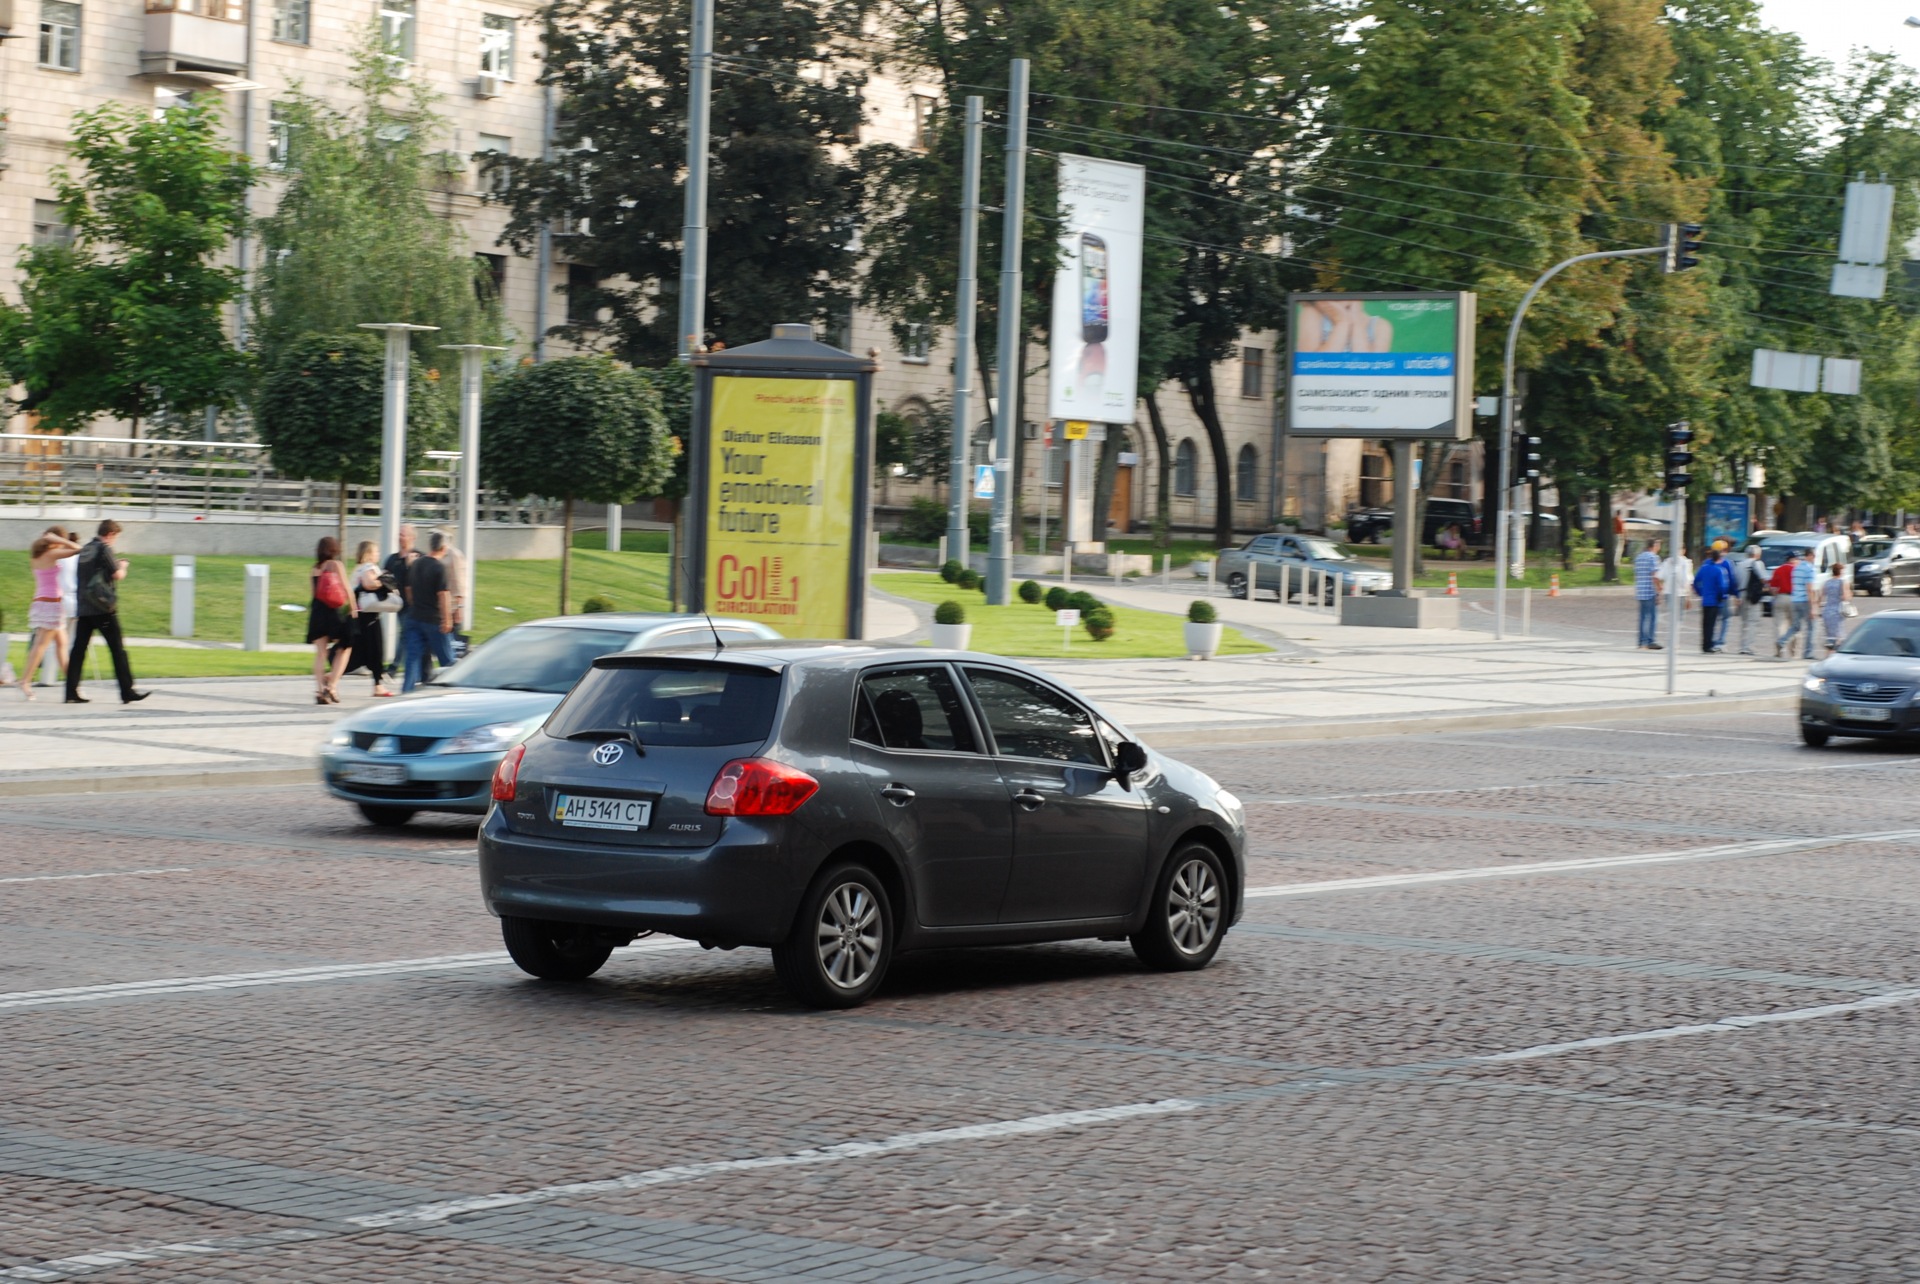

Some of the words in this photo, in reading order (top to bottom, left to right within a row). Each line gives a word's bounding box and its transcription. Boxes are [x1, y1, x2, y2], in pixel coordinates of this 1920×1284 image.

[768, 431, 823, 446] Eliasson
[720, 447, 767, 475] Your
[719, 479, 823, 506] emotional
[718, 505, 780, 534] future
[716, 601, 798, 615] CIRCULATION
[517, 812, 536, 820] TOYOTA
[565, 798, 586, 818] AH
[588, 800, 620, 820] 5141
[626, 803, 648, 822] CT
[668, 823, 702, 831] AURIS
